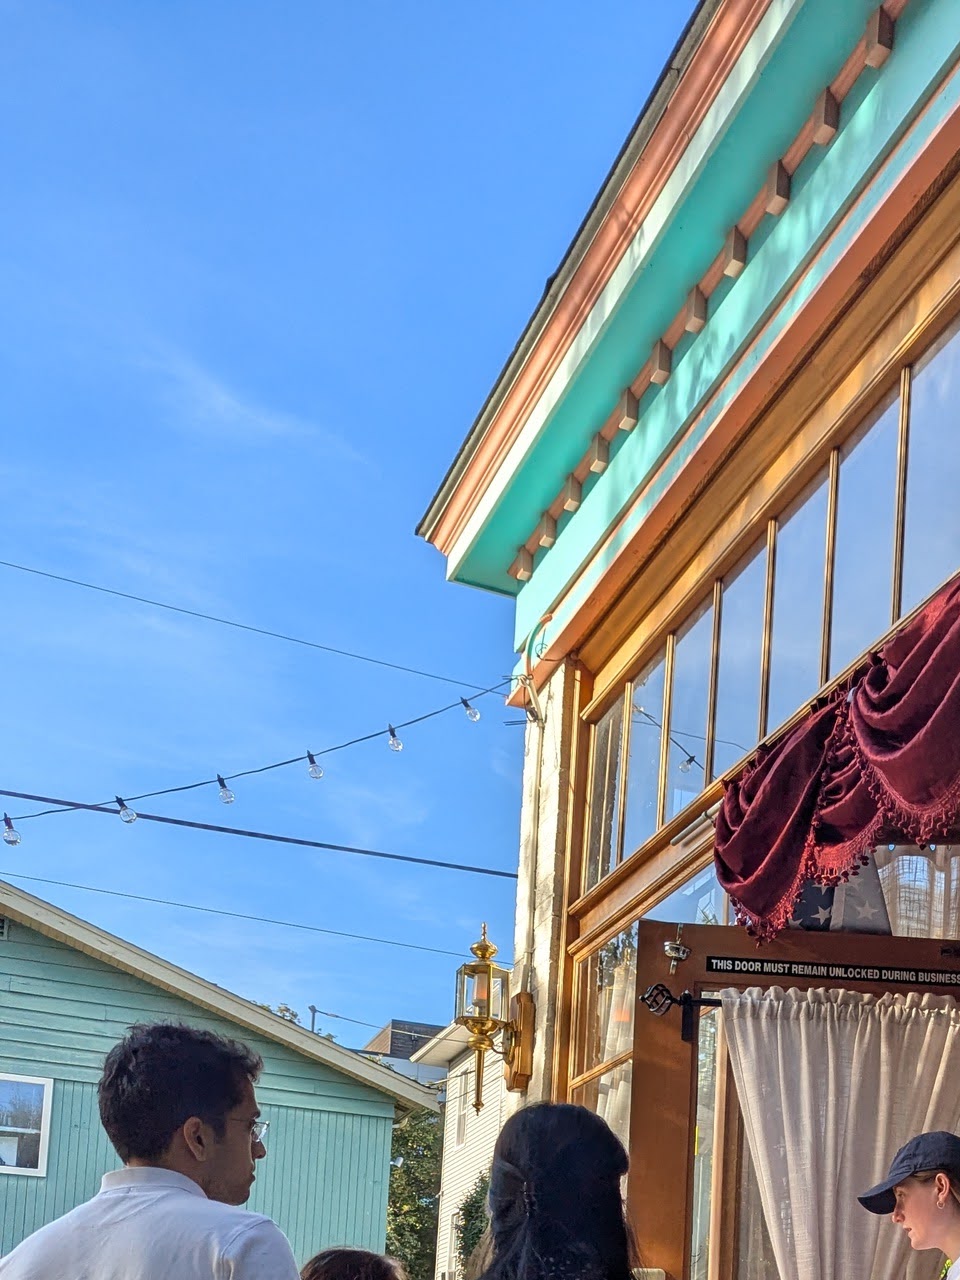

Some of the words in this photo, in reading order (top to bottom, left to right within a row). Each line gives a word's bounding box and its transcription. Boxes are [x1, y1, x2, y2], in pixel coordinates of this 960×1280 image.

[711, 959, 733, 970] THIS
[734, 961, 762, 972] DOOR
[763, 962, 790, 973] MUST
[791, 964, 828, 976] REMAIN
[829, 967, 880, 979] UNLOCKED
[881, 970, 916, 981] DURING
